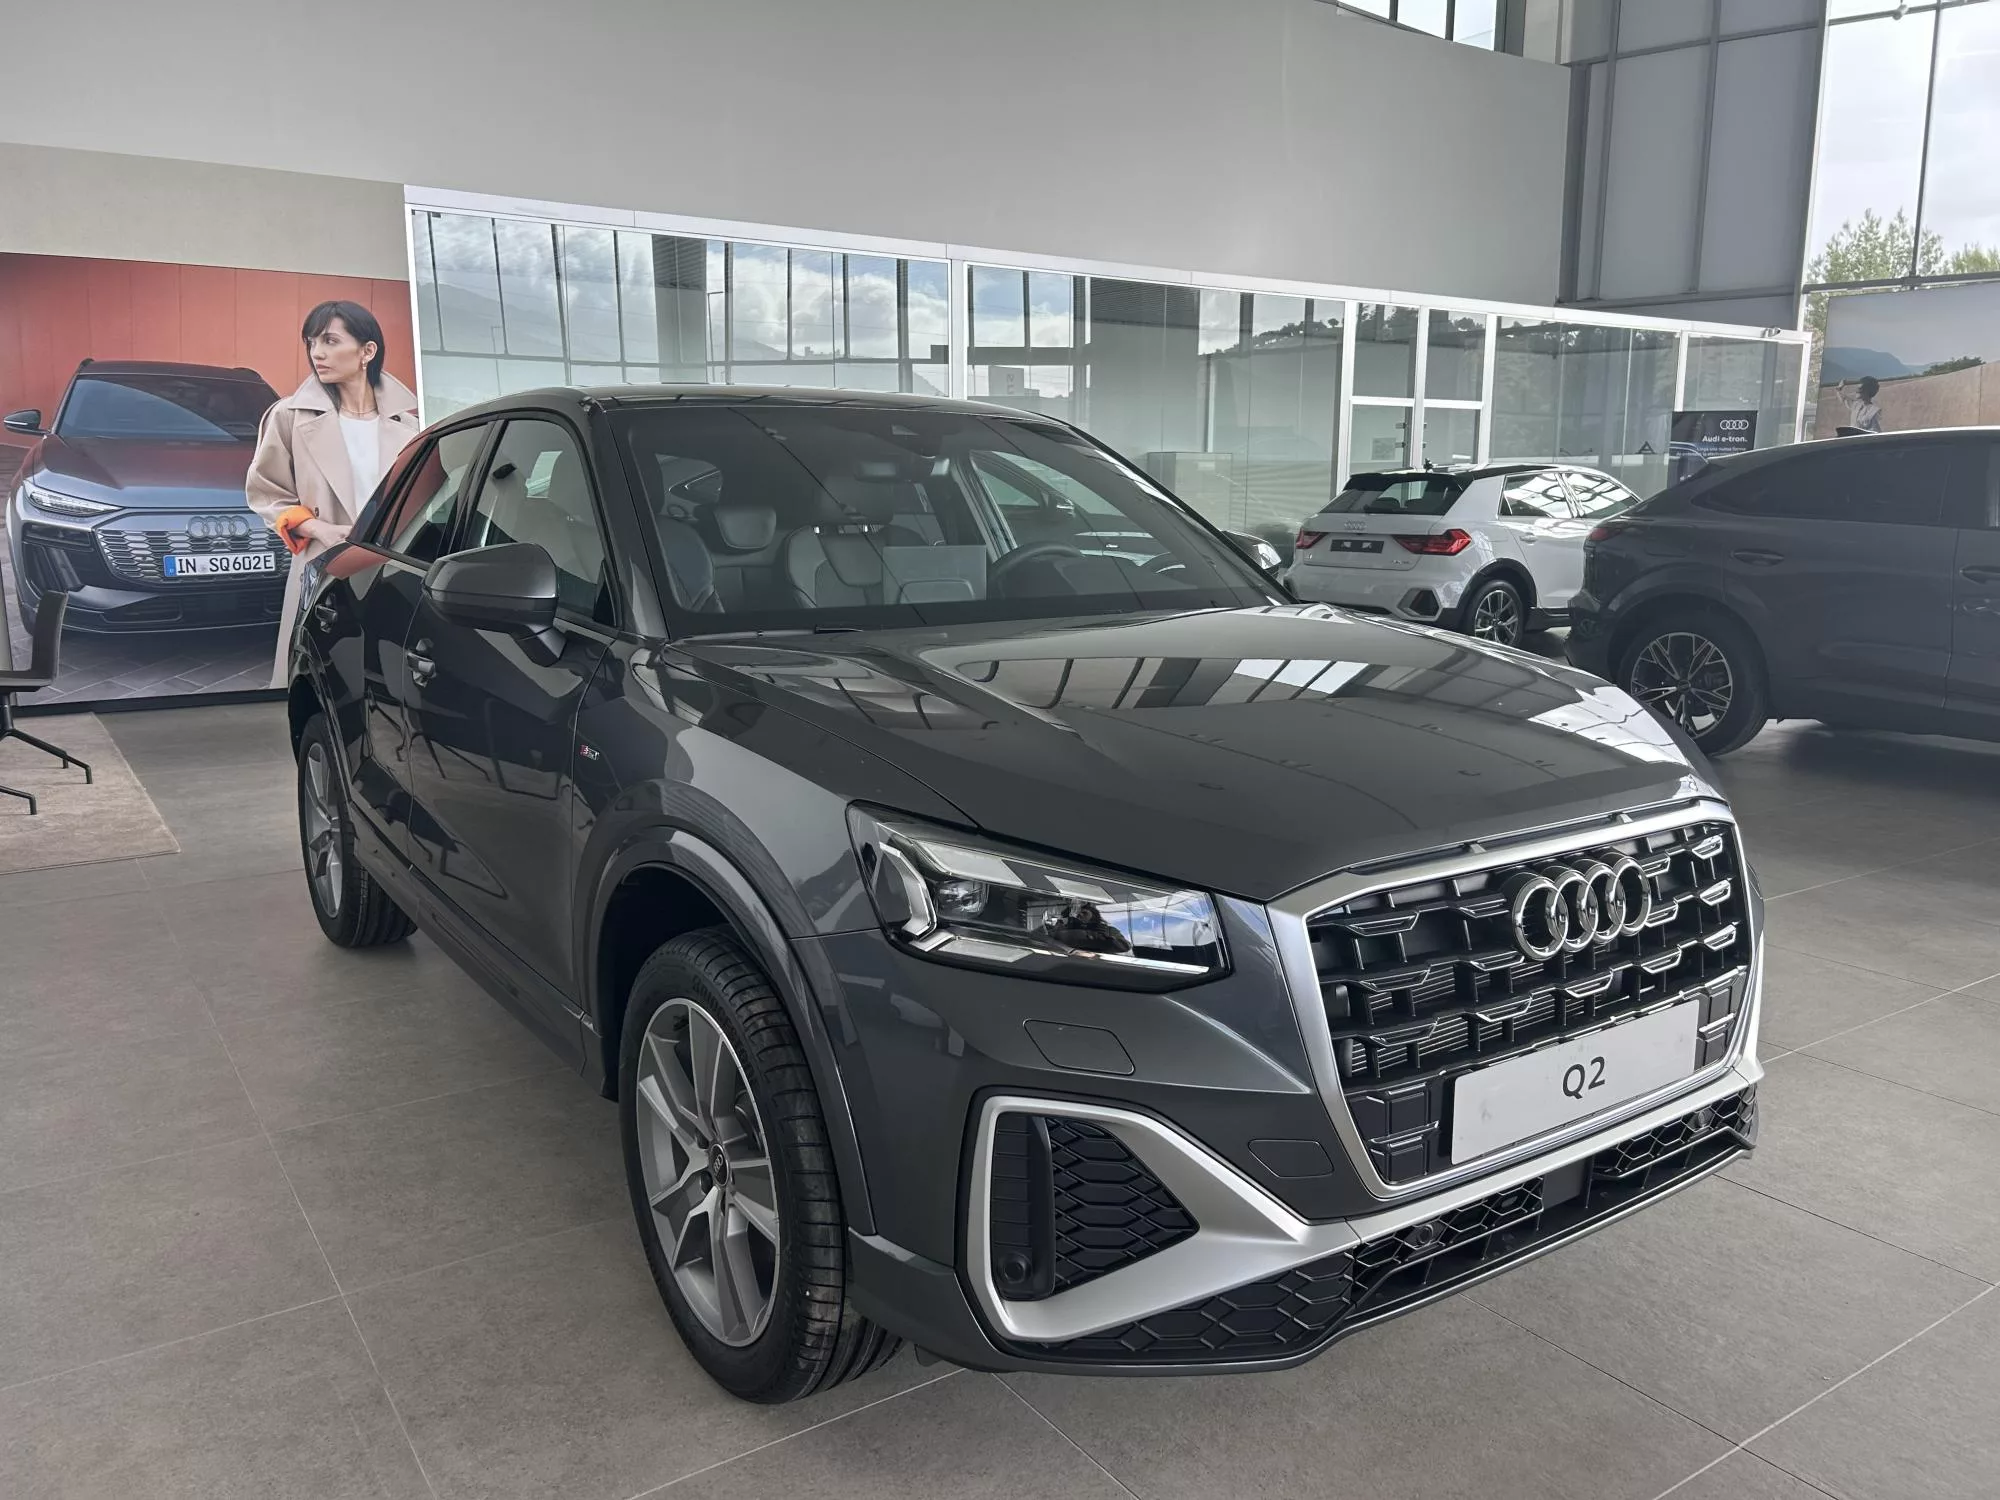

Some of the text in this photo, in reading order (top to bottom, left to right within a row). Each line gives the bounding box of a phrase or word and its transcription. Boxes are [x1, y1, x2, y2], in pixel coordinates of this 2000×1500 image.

[1702, 435, 1720, 443] Audi
[178, 558, 197, 574] IN
[1562, 1056, 1606, 1099] Q2
